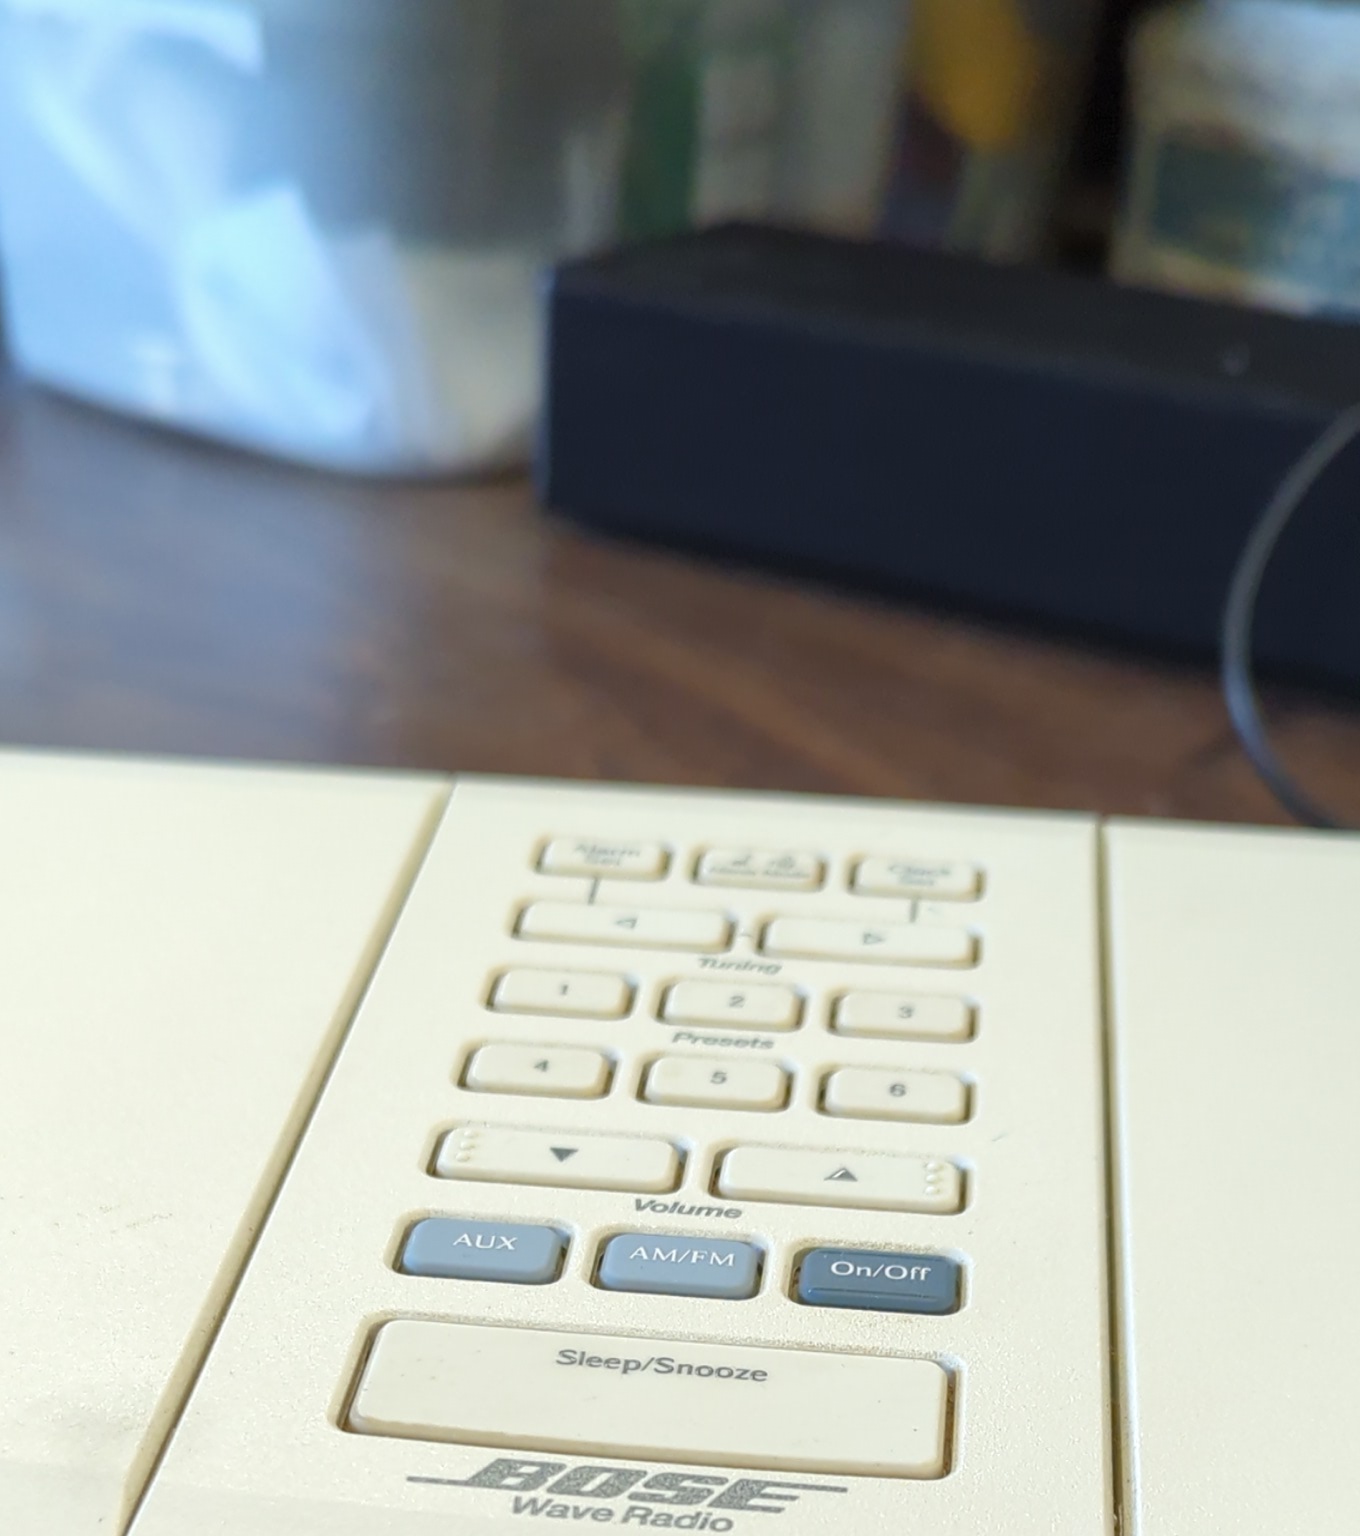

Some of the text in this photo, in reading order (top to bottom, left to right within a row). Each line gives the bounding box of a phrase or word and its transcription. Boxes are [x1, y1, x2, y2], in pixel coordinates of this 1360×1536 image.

[698, 957, 783, 975] Tuning
[558, 983, 570, 996] 1
[729, 995, 746, 1008] 2
[897, 1005, 916, 1019] 3
[671, 1031, 775, 1051] Presets
[534, 1059, 550, 1073] 4
[709, 1071, 728, 1085] 5
[888, 1083, 907, 1097] 6
[633, 1199, 744, 1220] Volume
[452, 1233, 518, 1251] AUX
[629, 1246, 736, 1268] AM/FM
[830, 1260, 932, 1283] On/Off
[554, 1348, 769, 1384] Sleep/Snooze
[406, 1457, 848, 1514] BOSE
[510, 1495, 734, 1533] Wave Radio
